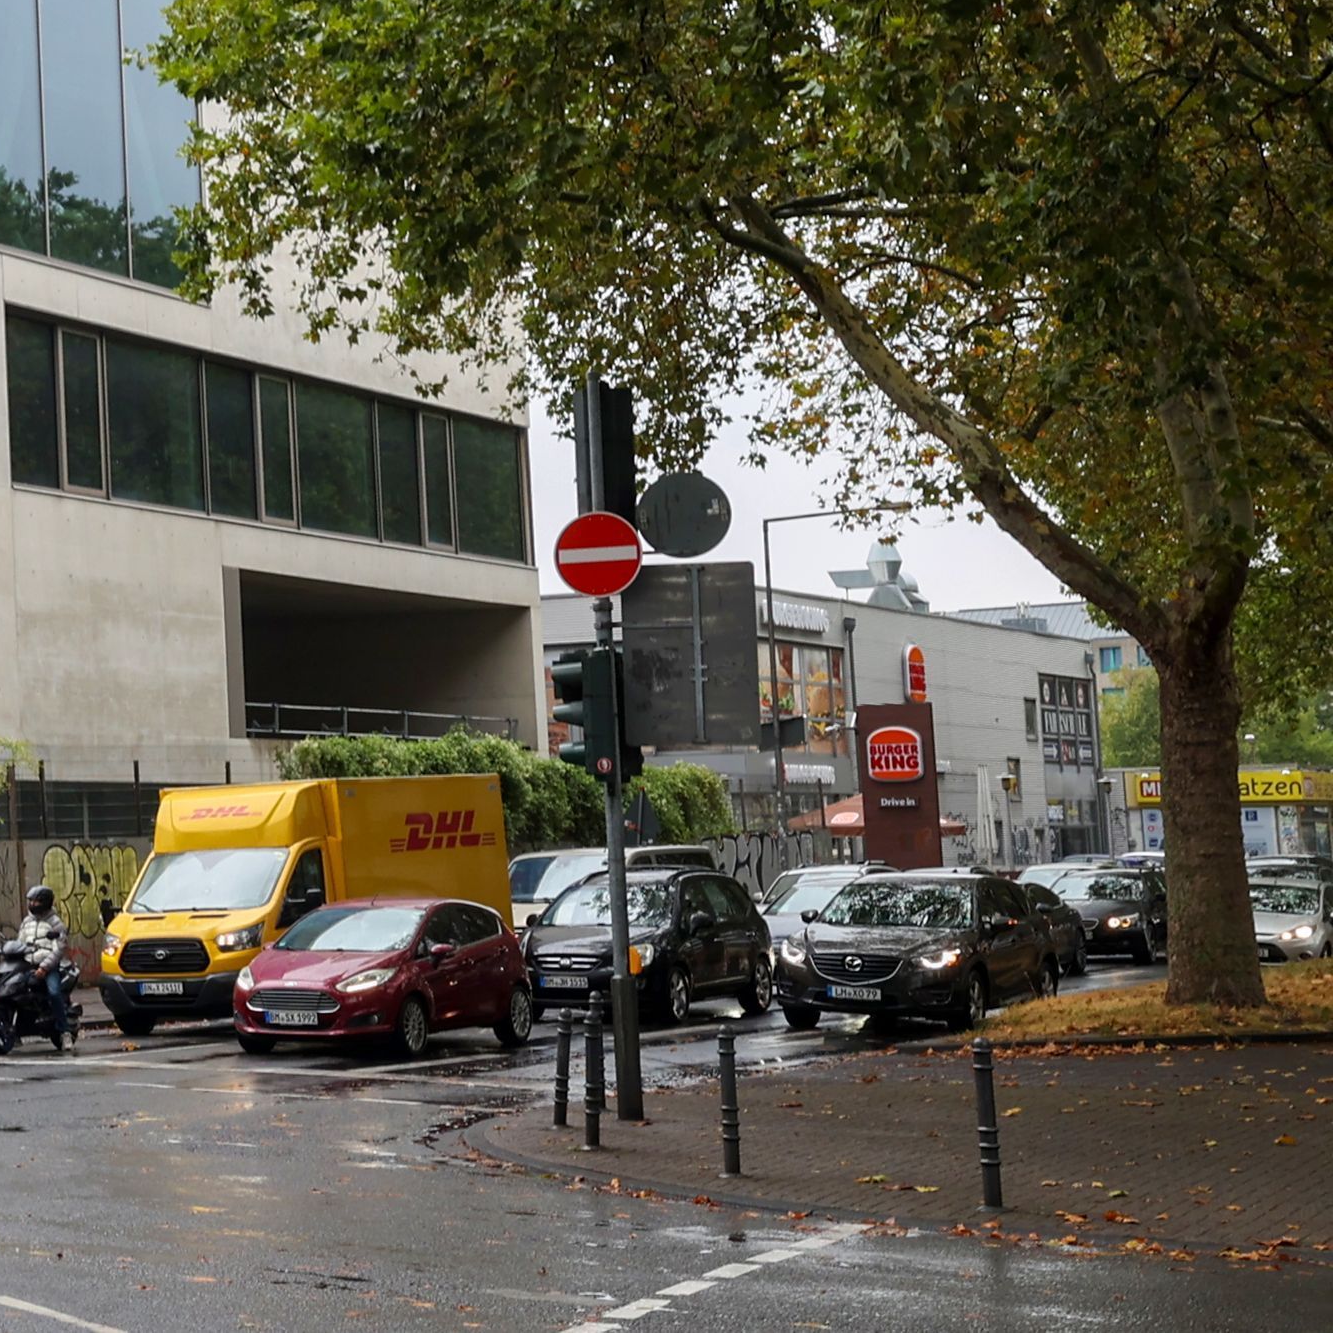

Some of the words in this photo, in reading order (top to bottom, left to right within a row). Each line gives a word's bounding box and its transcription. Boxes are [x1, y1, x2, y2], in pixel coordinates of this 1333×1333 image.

[870, 744, 919, 756] BURGER
[870, 755, 920, 770] KING
[1240, 778, 1302, 797] atzen
[881, 797, 906, 807] Drive
[906, 797, 916, 806] in
[190, 806, 251, 819] DHL
[405, 810, 481, 851] DHL
[298, 1011, 317, 1022] 1992
